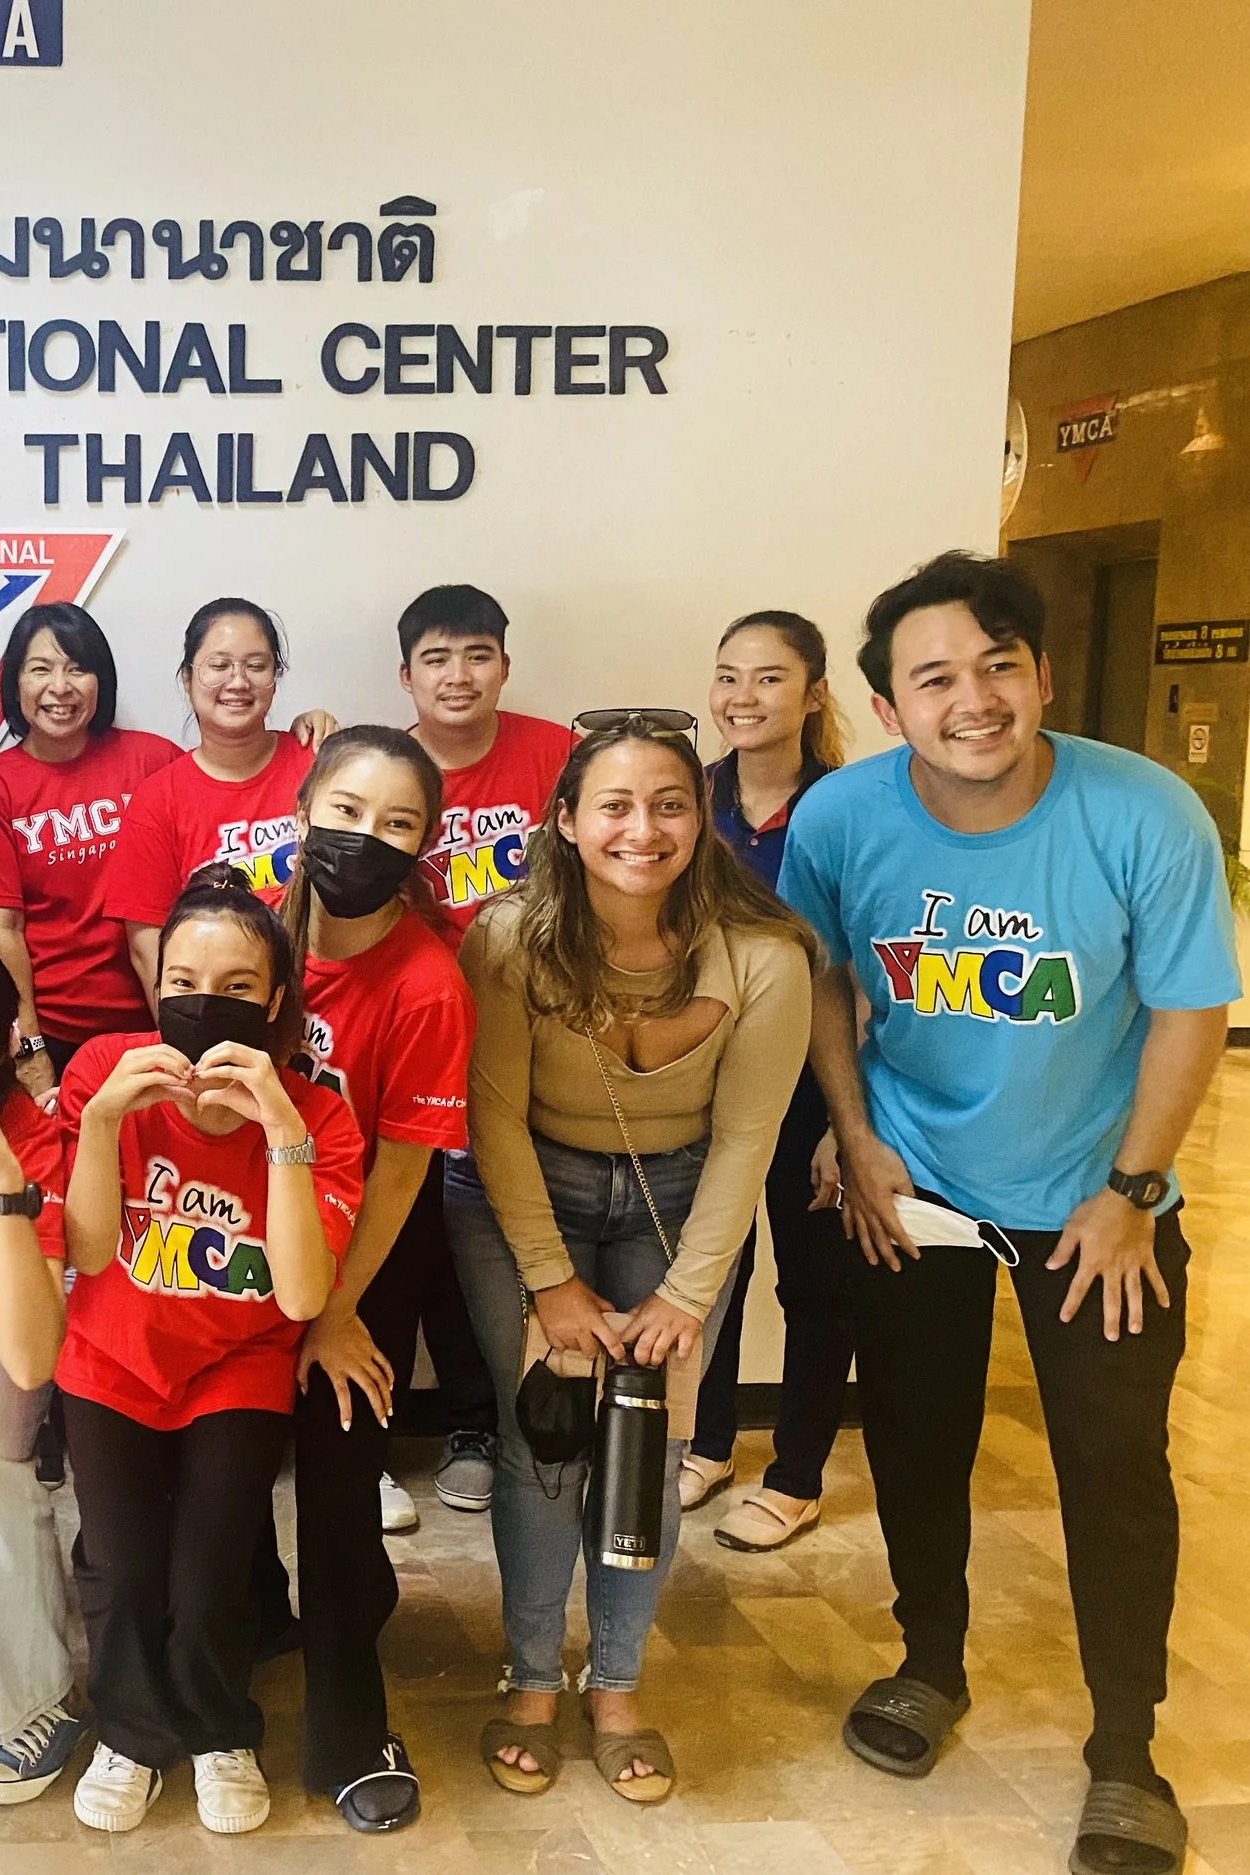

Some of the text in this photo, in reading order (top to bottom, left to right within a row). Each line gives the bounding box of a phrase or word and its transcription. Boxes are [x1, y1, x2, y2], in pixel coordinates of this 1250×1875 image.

[320, 322, 669, 396] CENTER
[1060, 415, 1113, 447] YMCA
[23, 430, 476, 504] THAILAND
[12, 793, 133, 854] YMC
[221, 819, 298, 854] I am
[443, 810, 523, 845] I am
[418, 832, 540, 905] YMC
[914, 892, 1041, 939] I am
[871, 940, 1077, 1022] YMCA
[147, 1162, 242, 1225] I am
[119, 1204, 274, 1298] YMCA
[616, 1536, 643, 1549] YETI
